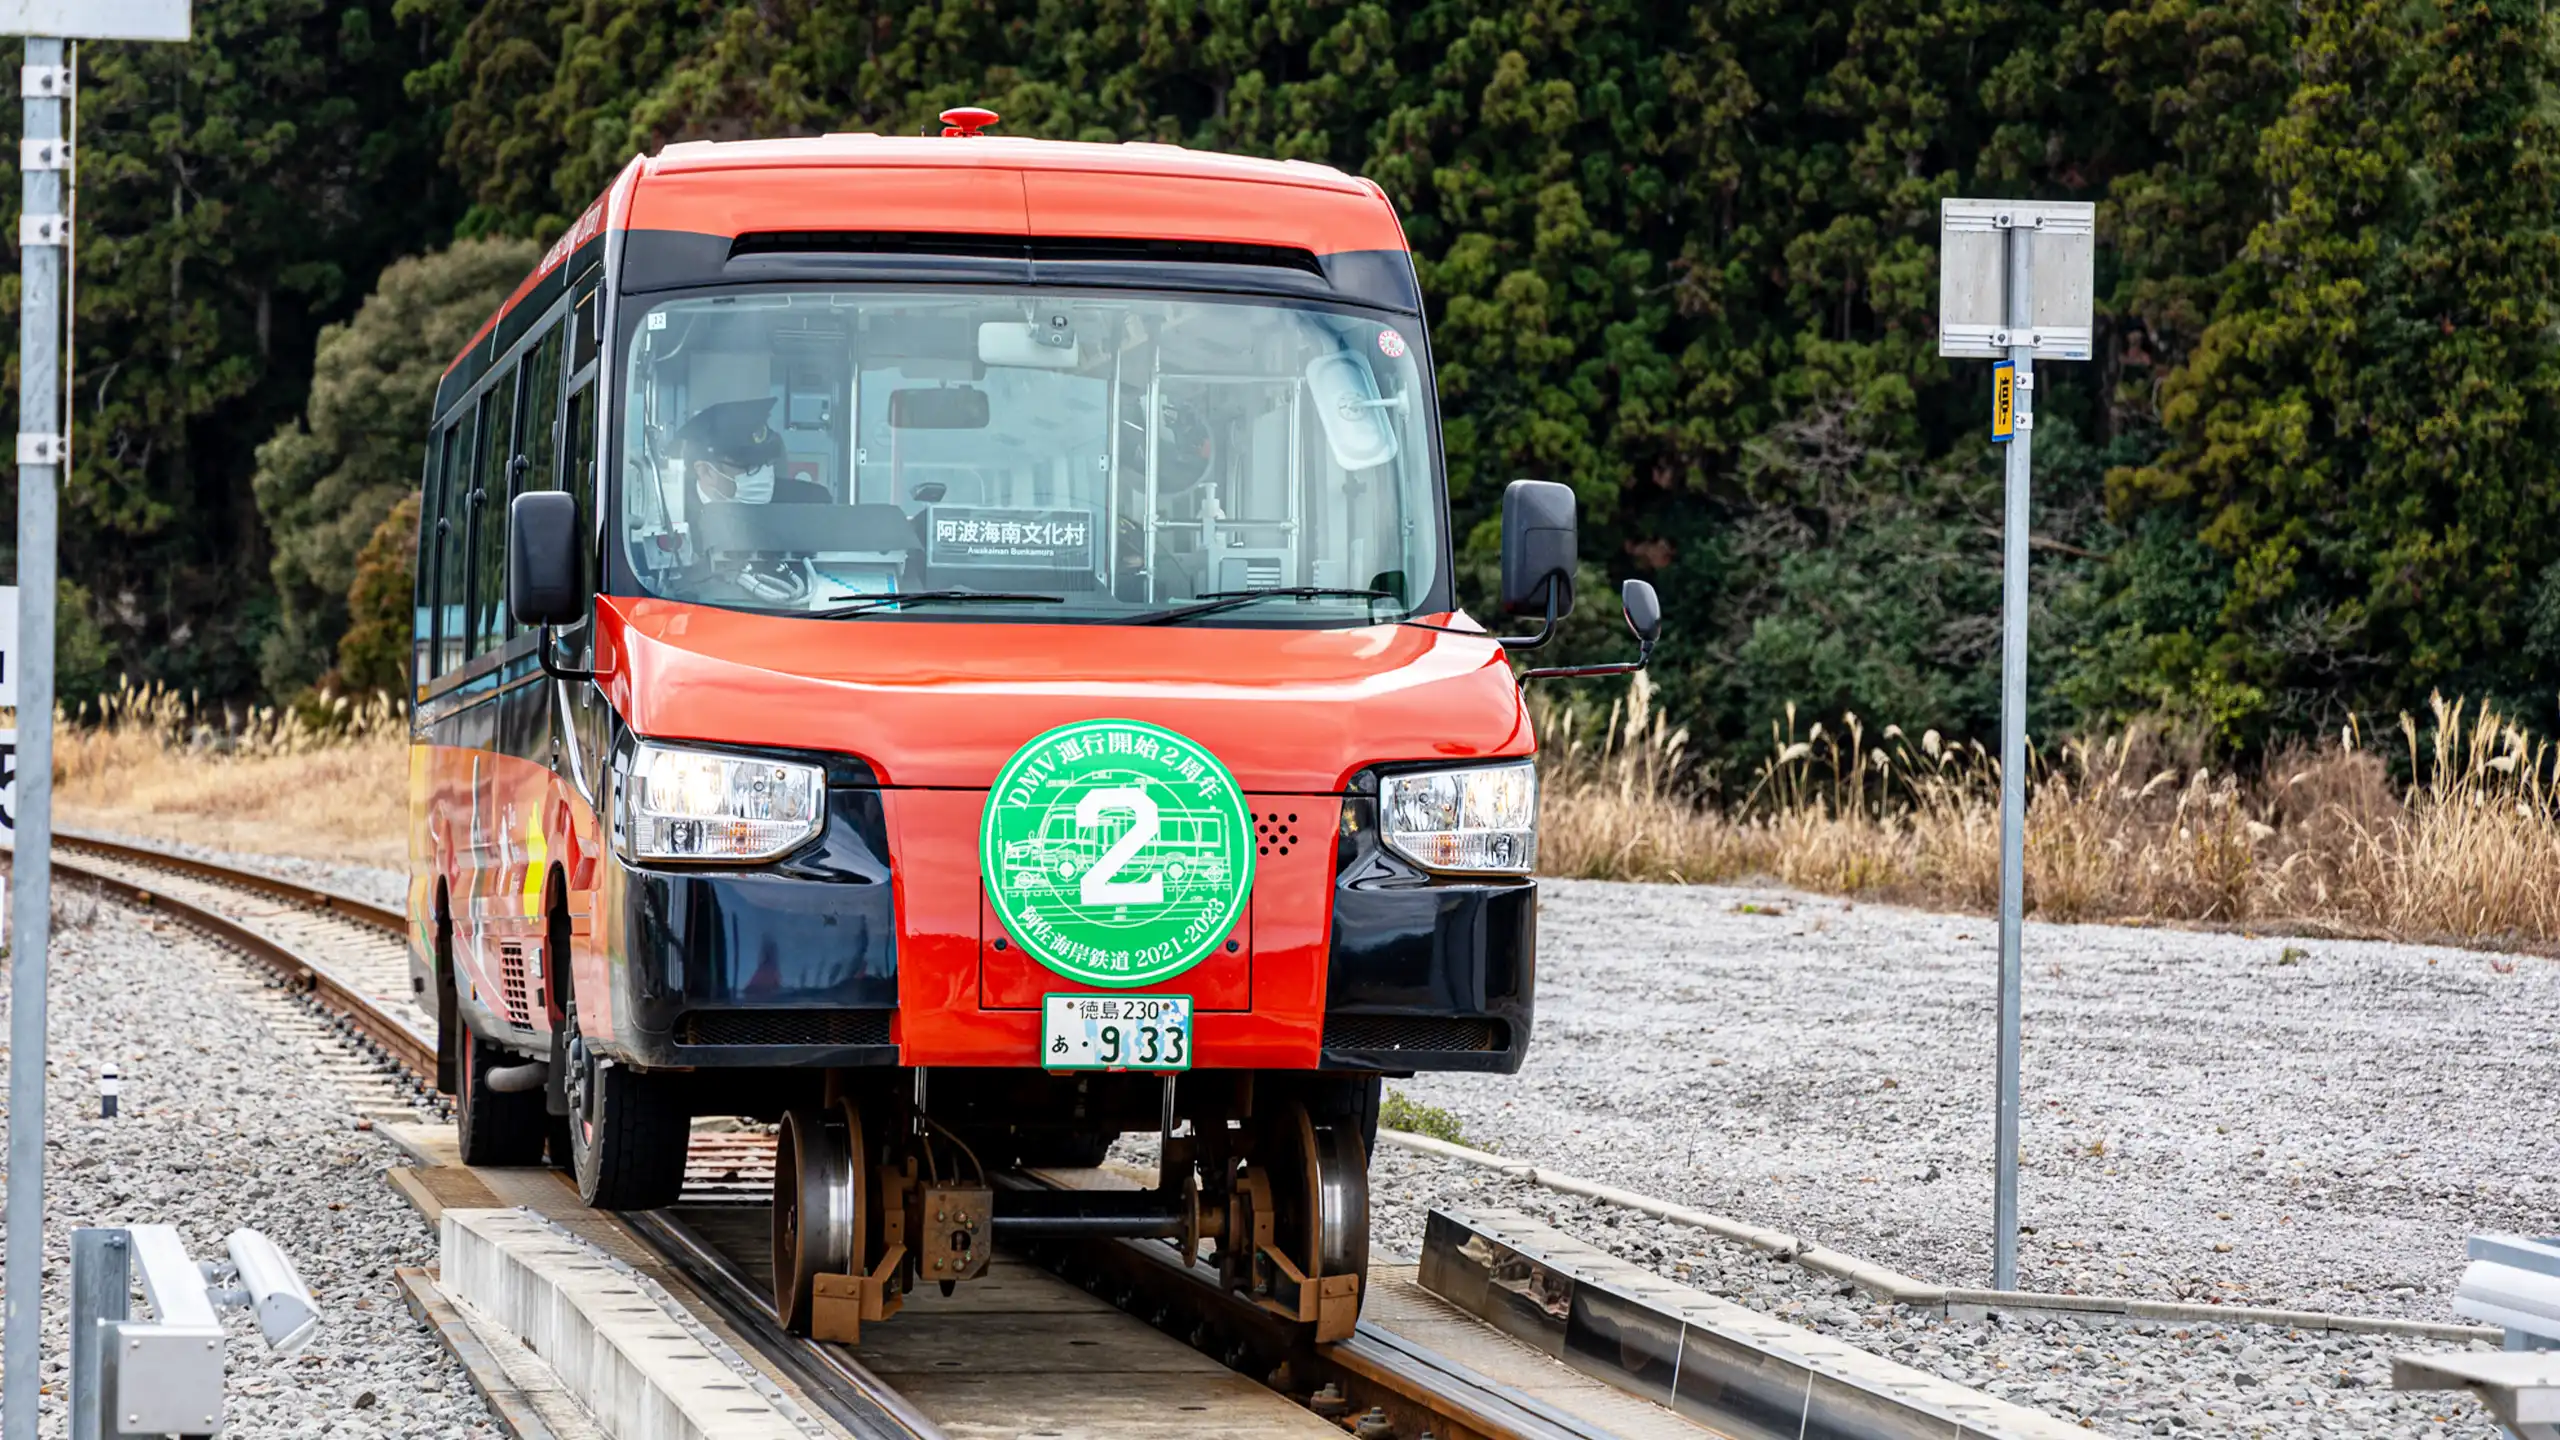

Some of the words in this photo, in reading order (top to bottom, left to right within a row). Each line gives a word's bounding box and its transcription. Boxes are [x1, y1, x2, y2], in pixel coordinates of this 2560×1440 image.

[936, 519, 1086, 546] 阿波海南文化村
[967, 546, 1009, 555] Awakainan
[1010, 547, 1054, 557] Bunkamura
[1007, 751, 1057, 811] DMV
[1075, 787, 1164, 905] 2
[1017, 904, 1130, 971] 阿佐海岸鉄道
[1135, 897, 1226, 968] 2021-2023
[1051, 1034, 1069, 1054] あ
